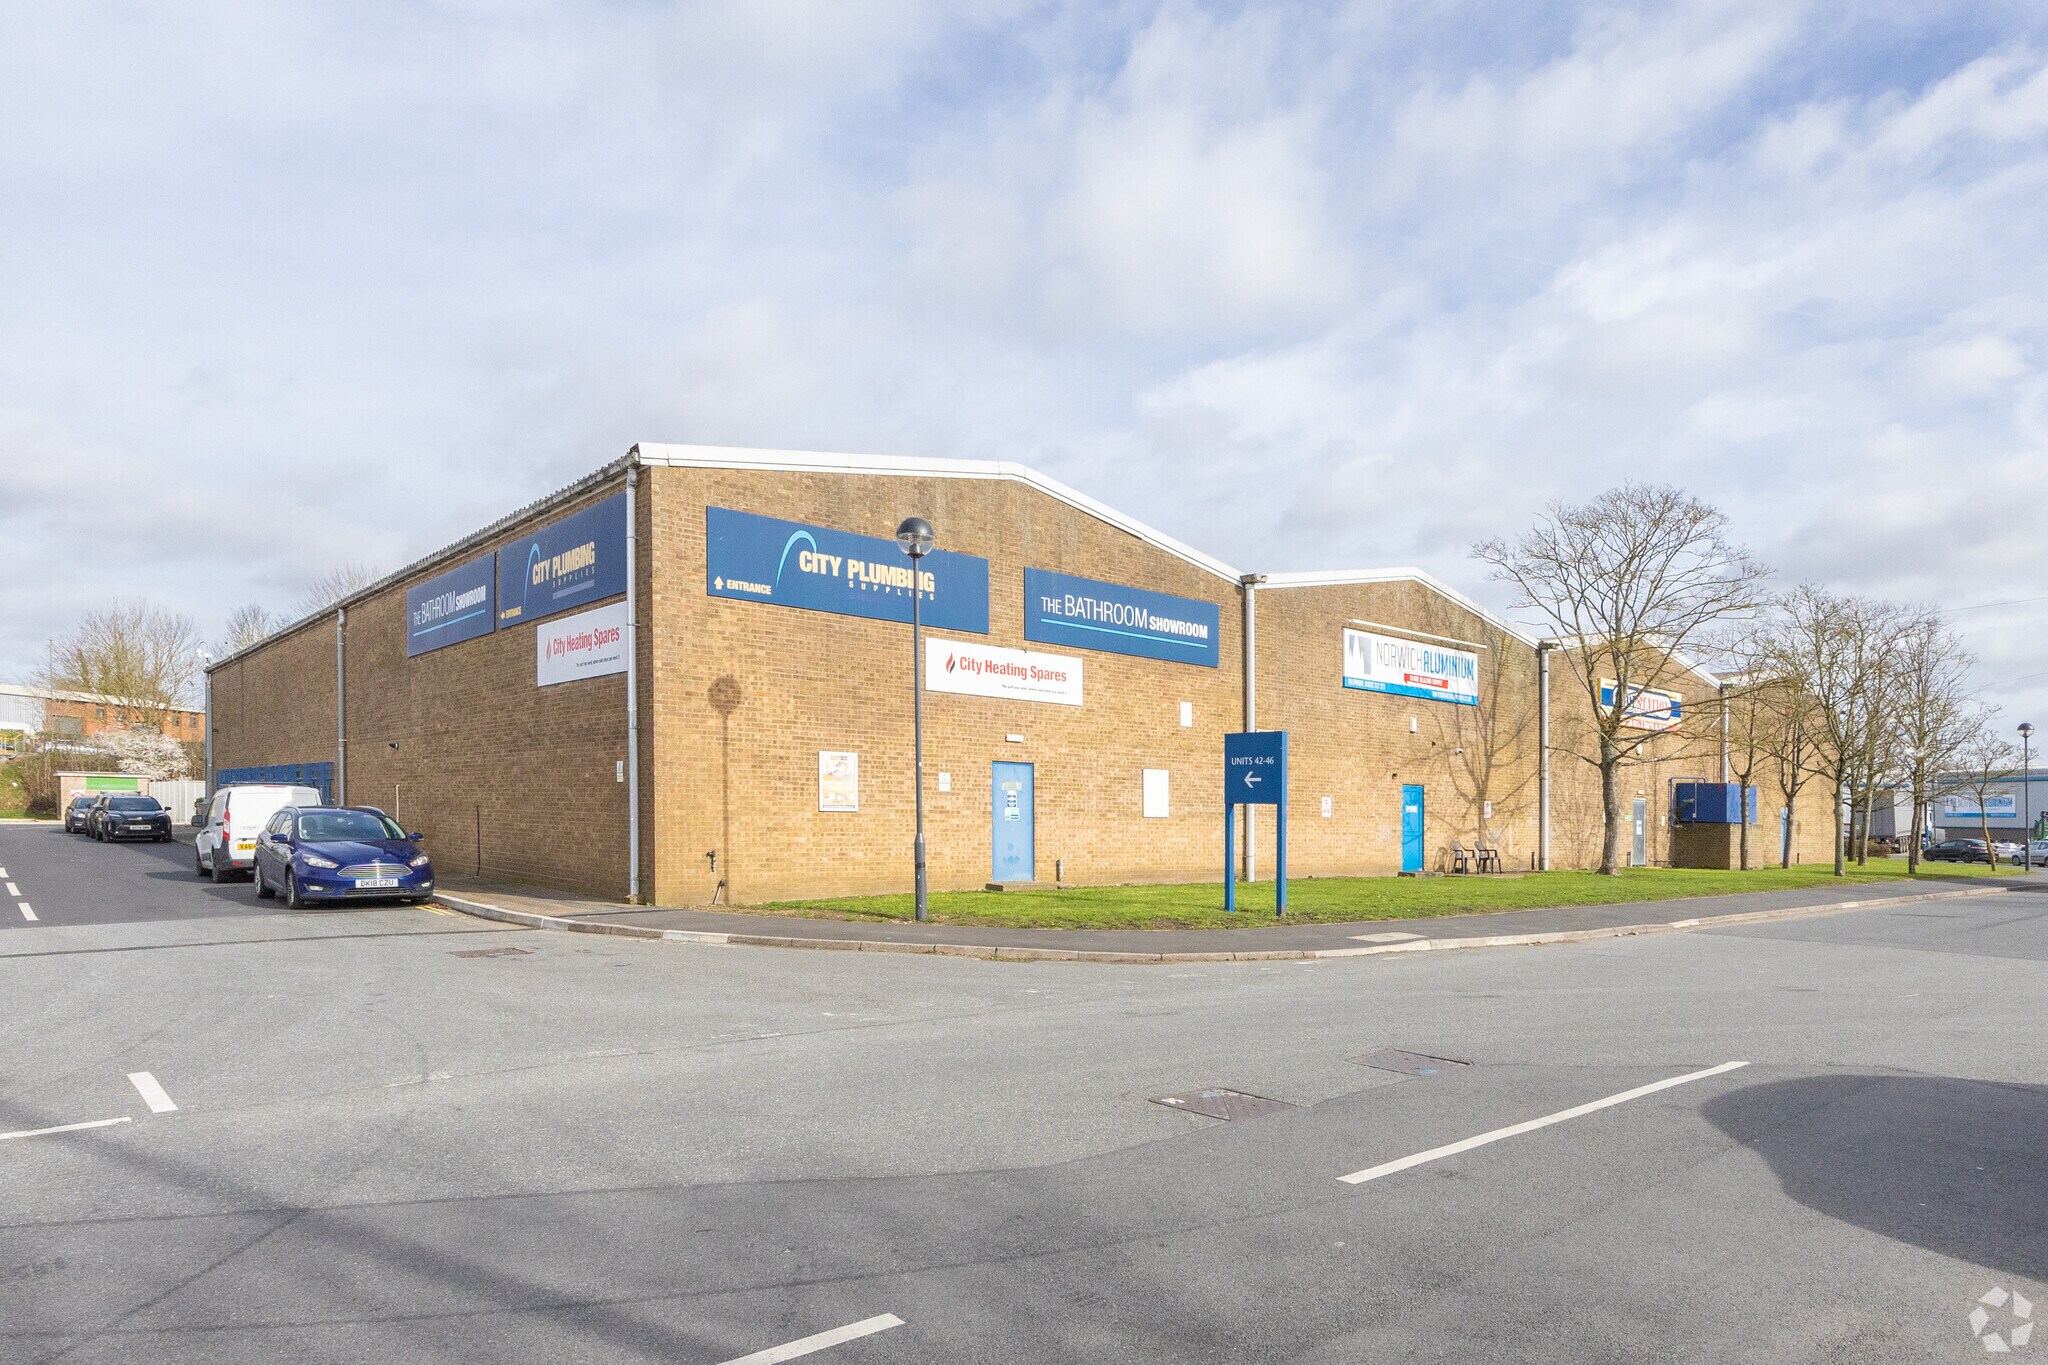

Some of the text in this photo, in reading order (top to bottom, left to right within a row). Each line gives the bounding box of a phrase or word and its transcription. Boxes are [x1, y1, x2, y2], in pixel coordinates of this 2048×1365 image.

[532, 541, 595, 586] CITY PLUMBING
[799, 550, 843, 577] CITY
[552, 566, 595, 588] SUPPLIES
[726, 579, 772, 595] ENTRANCE
[848, 580, 935, 601] SUPPLIES
[413, 584, 487, 627] THE BATHROOM SHOWROOM
[505, 605, 522, 619] ENTRANCE
[1040, 594, 1208, 639] THE BATHROOM SHOWROOM
[553, 626, 620, 657] City Heating Spares
[959, 656, 1067, 682] City Heating Spares
[1231, 756, 1275, 766] UNITS 42-46
[360, 879, 394, 887] DK18 CZU
